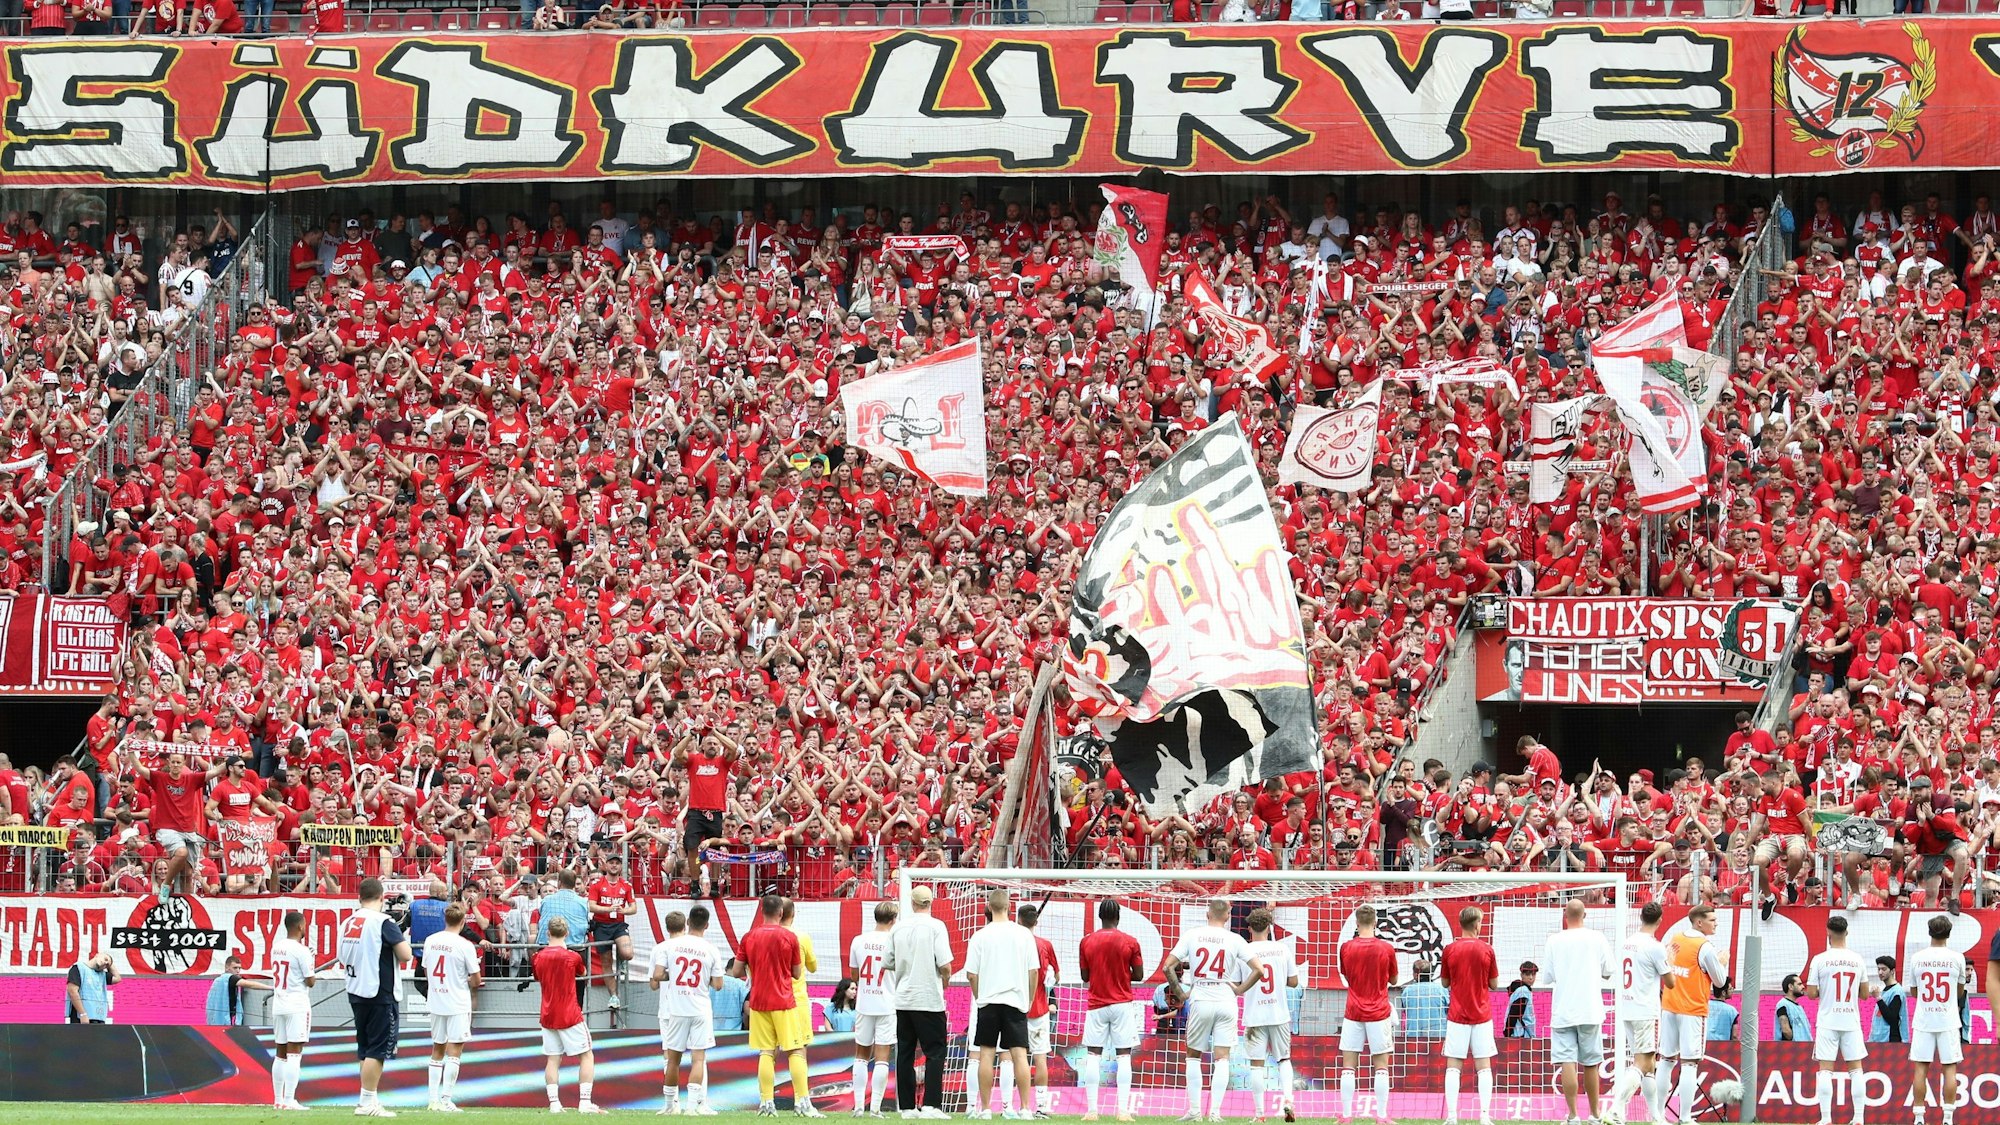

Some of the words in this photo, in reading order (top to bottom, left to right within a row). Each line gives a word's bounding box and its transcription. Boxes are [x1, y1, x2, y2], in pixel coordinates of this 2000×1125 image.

[319, 2, 339, 12] REWE
[2, 26, 1743, 184] SÜDKURVE
[1832, 71, 1883, 119] 12
[183, 279, 194, 296] 9
[1372, 281, 1448, 293] DOUBLESIEGER
[1507, 600, 1648, 637] CHAOTIX
[1649, 605, 1723, 641] SPS
[57, 627, 115, 649] ULTRAS
[1524, 641, 1644, 670] HÖHER
[1649, 646, 1723, 681] CGN
[1523, 672, 1643, 703] JUNGS
[147, 740, 222, 757] SYNDIKAT
[1767, 808, 1788, 818] REWE
[1613, 855, 1636, 864] REWE
[600, 896, 625, 905] REWE
[0, 907, 107, 968] TADT
[168, 931, 220, 948] 2007
[430, 943, 453, 954] HÜBERS
[272, 960, 290, 990] 37
[432, 954, 446, 984] 4
[675, 957, 703, 988] 23
[859, 954, 886, 987] 47
[1194, 946, 1226, 979] 24
[1671, 964, 1691, 979] EWE
[1831, 970, 1857, 1003] 17
[1920, 971, 1951, 1004] 35
[1758, 1069, 1893, 1108] AUTO
